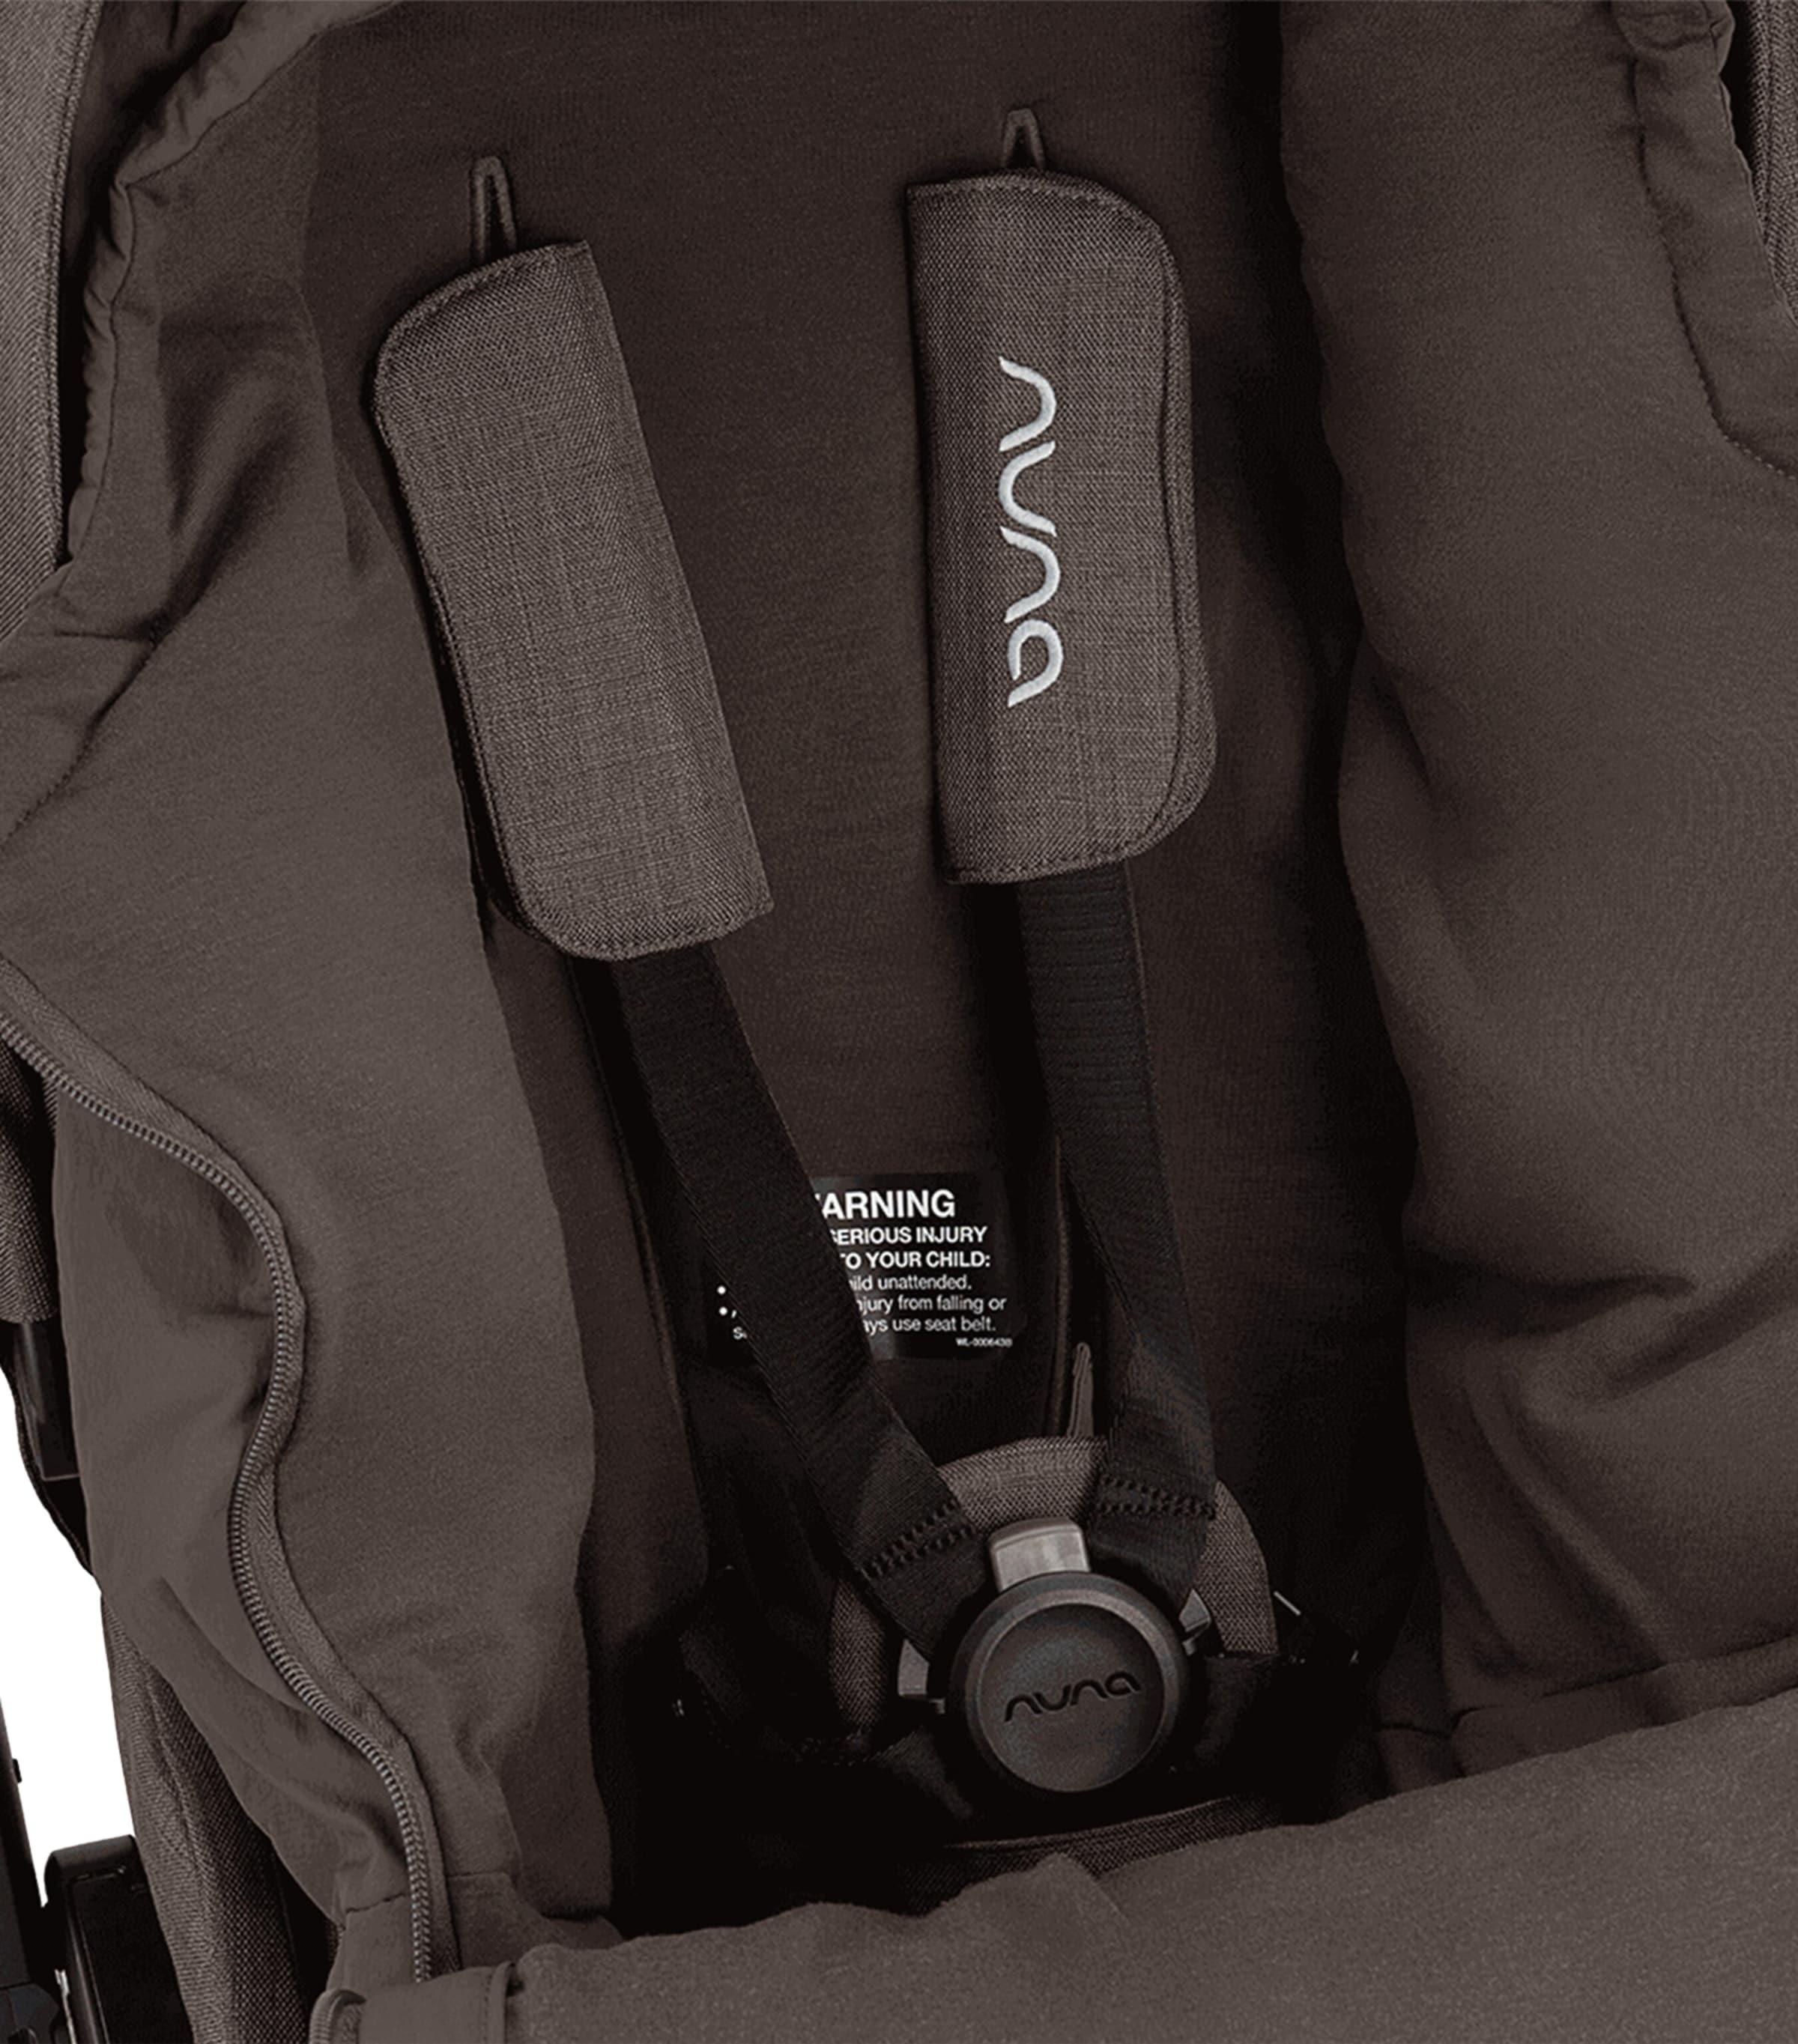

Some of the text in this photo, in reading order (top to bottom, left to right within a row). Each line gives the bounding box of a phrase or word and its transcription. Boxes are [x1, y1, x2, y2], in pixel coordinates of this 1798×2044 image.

[998, 355, 1064, 708] nuna
[814, 1189, 955, 1219] ARNING
[915, 1225, 987, 1243] INJURY
[840, 1250, 990, 1270] O YOUR CHILD:
[877, 1273, 972, 1290] unattended.
[898, 1294, 933, 1310] from
[936, 1294, 984, 1314] falling
[988, 1298, 1007, 1311] or
[892, 1318, 921, 1332] use
[924, 1316, 957, 1332] seat
[960, 1315, 996, 1332] belt.
[1005, 1671, 1141, 1723] nuna
